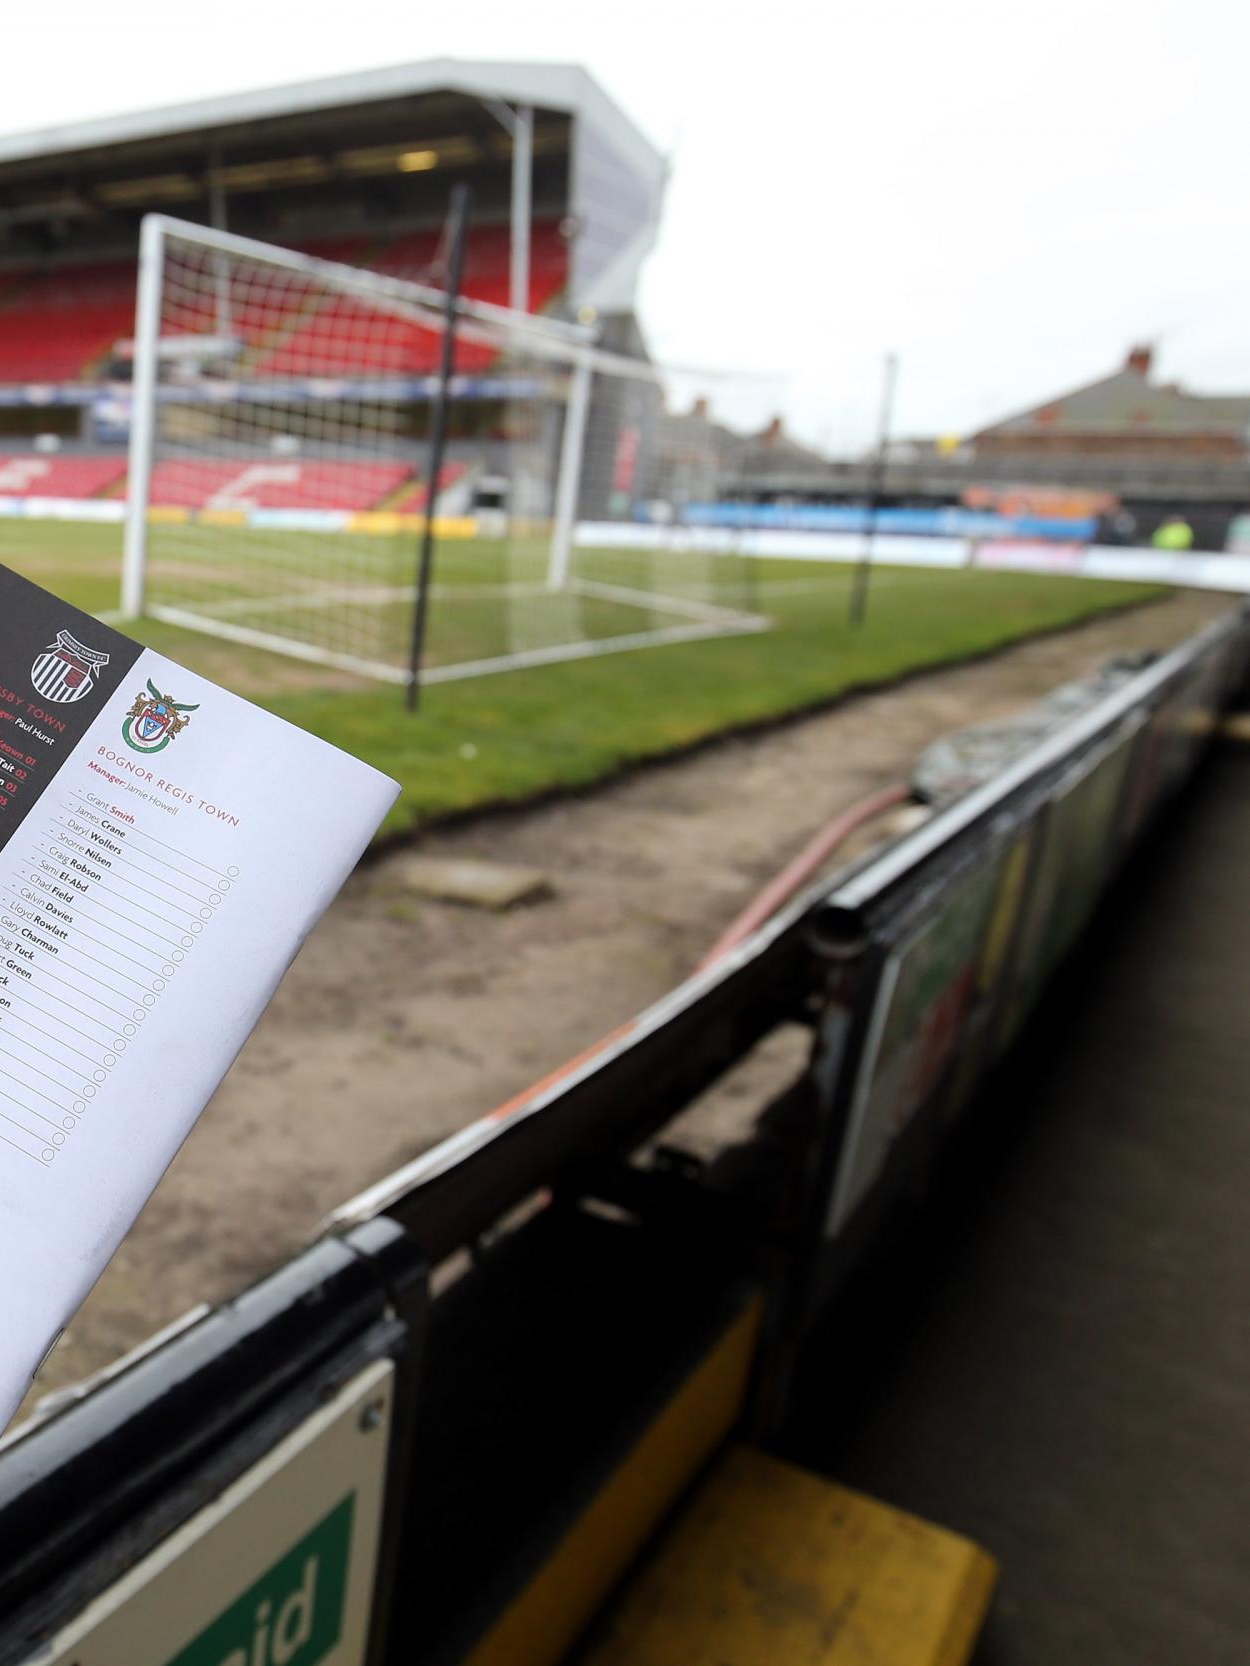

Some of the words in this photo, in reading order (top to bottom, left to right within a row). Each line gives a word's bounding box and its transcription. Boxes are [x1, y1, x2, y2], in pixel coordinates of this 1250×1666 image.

[15, 717, 32, 732] Paul
[32, 728, 55, 746] Hurst
[27, 703, 67, 732] TOWN
[14, 769, 27, 779] 02
[25, 756, 36, 767] 01
[5, 782, 17, 793] 03
[97, 746, 154, 782] BOGNOR
[157, 779, 194, 804] REGIS
[199, 799, 239, 827] TOWN
[125, 783, 148, 800] Jamie
[149, 795, 180, 816] Howell
[76, 806, 101, 823] James
[101, 820, 126, 838] Crane
[86, 792, 110, 810] Grant
[110, 806, 135, 825] Smith
[58, 832, 85, 852] Snorre
[85, 848, 112, 868] Nilsen
[67, 819, 90, 837] Daryl
[90, 831, 123, 855] Wollers
[39, 859, 60, 876] Sami
[59, 872, 89, 893] El-Abd
[49, 846, 70, 865] Craig
[70, 858, 102, 881] Robson
[30, 873, 53, 891] Chad
[51, 886, 74, 904] Field
[10, 901, 35, 920] Lloyd
[33, 915, 69, 940] Rowlatt
[20, 887, 46, 907] Calvin
[45, 902, 73, 924] Davies
[0, 915, 21, 932] Gary
[21, 928, 59, 955] Charman
[14, 943, 35, 961] Tuck
[6, 959, 32, 980] Green
[217, 1552, 318, 1666] id
